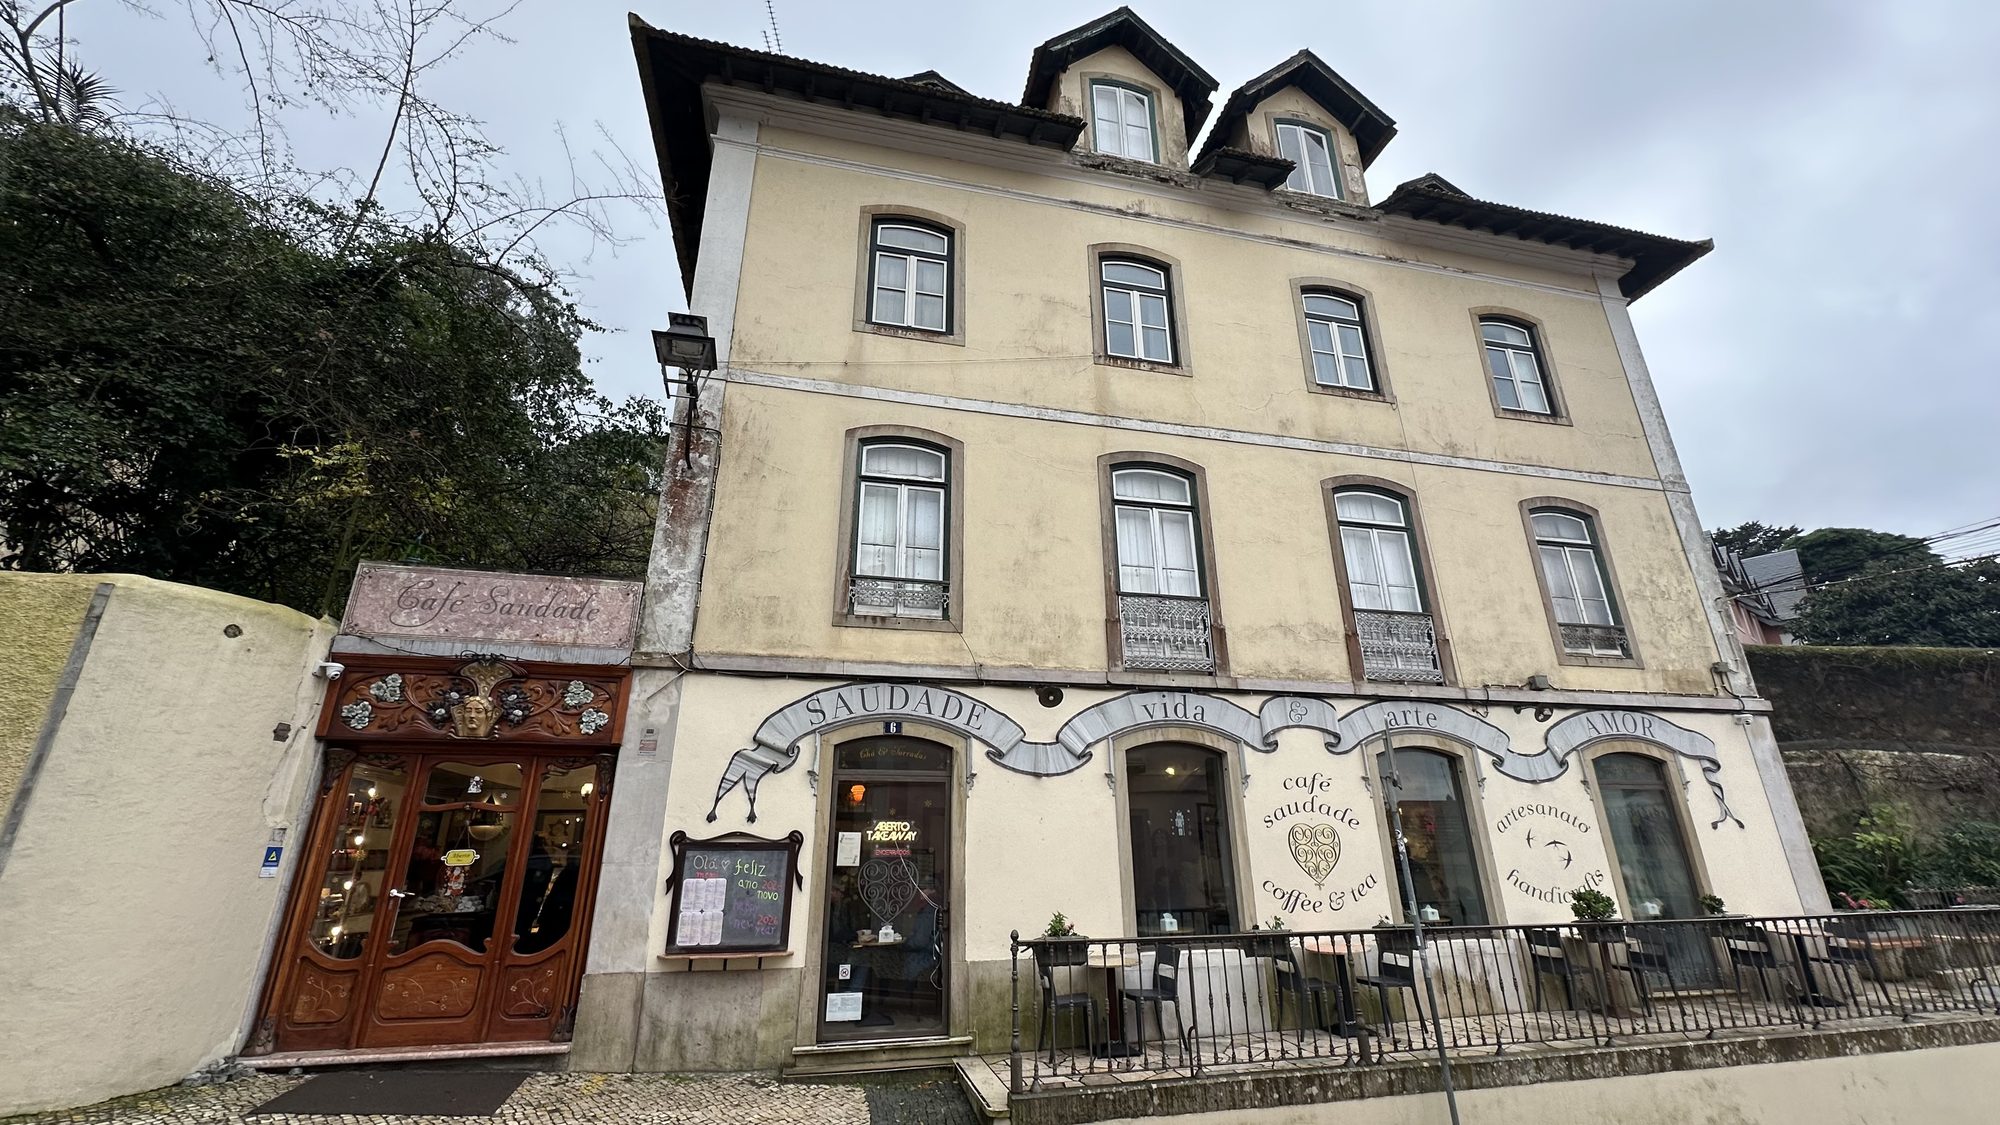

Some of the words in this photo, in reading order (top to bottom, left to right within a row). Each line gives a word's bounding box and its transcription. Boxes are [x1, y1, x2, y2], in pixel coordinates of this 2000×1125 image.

[389, 580, 469, 628] Café
[474, 584, 601, 622] Saudade
[805, 685, 987, 731] SAUDADE
[1142, 694, 1207, 723] vida
[1288, 700, 1308, 723] &
[1387, 706, 1438, 729] arte
[1585, 712, 1656, 739] AMOR
[889, 721, 898, 734] 6
[1283, 772, 1332, 795] café
[1263, 794, 1360, 830] saudade
[1496, 803, 1591, 834] artesanato
[866, 831, 918, 841] TAKEAWAY
[874, 821, 911, 831] ABERTO
[693, 854, 718, 870] Olá
[733, 858, 767, 877] feliz
[738, 879, 758, 890] ano
[757, 890, 779, 901] novo
[1262, 880, 1323, 914] coffee
[1329, 891, 1346, 911] &
[1350, 873, 1377, 902] tea
